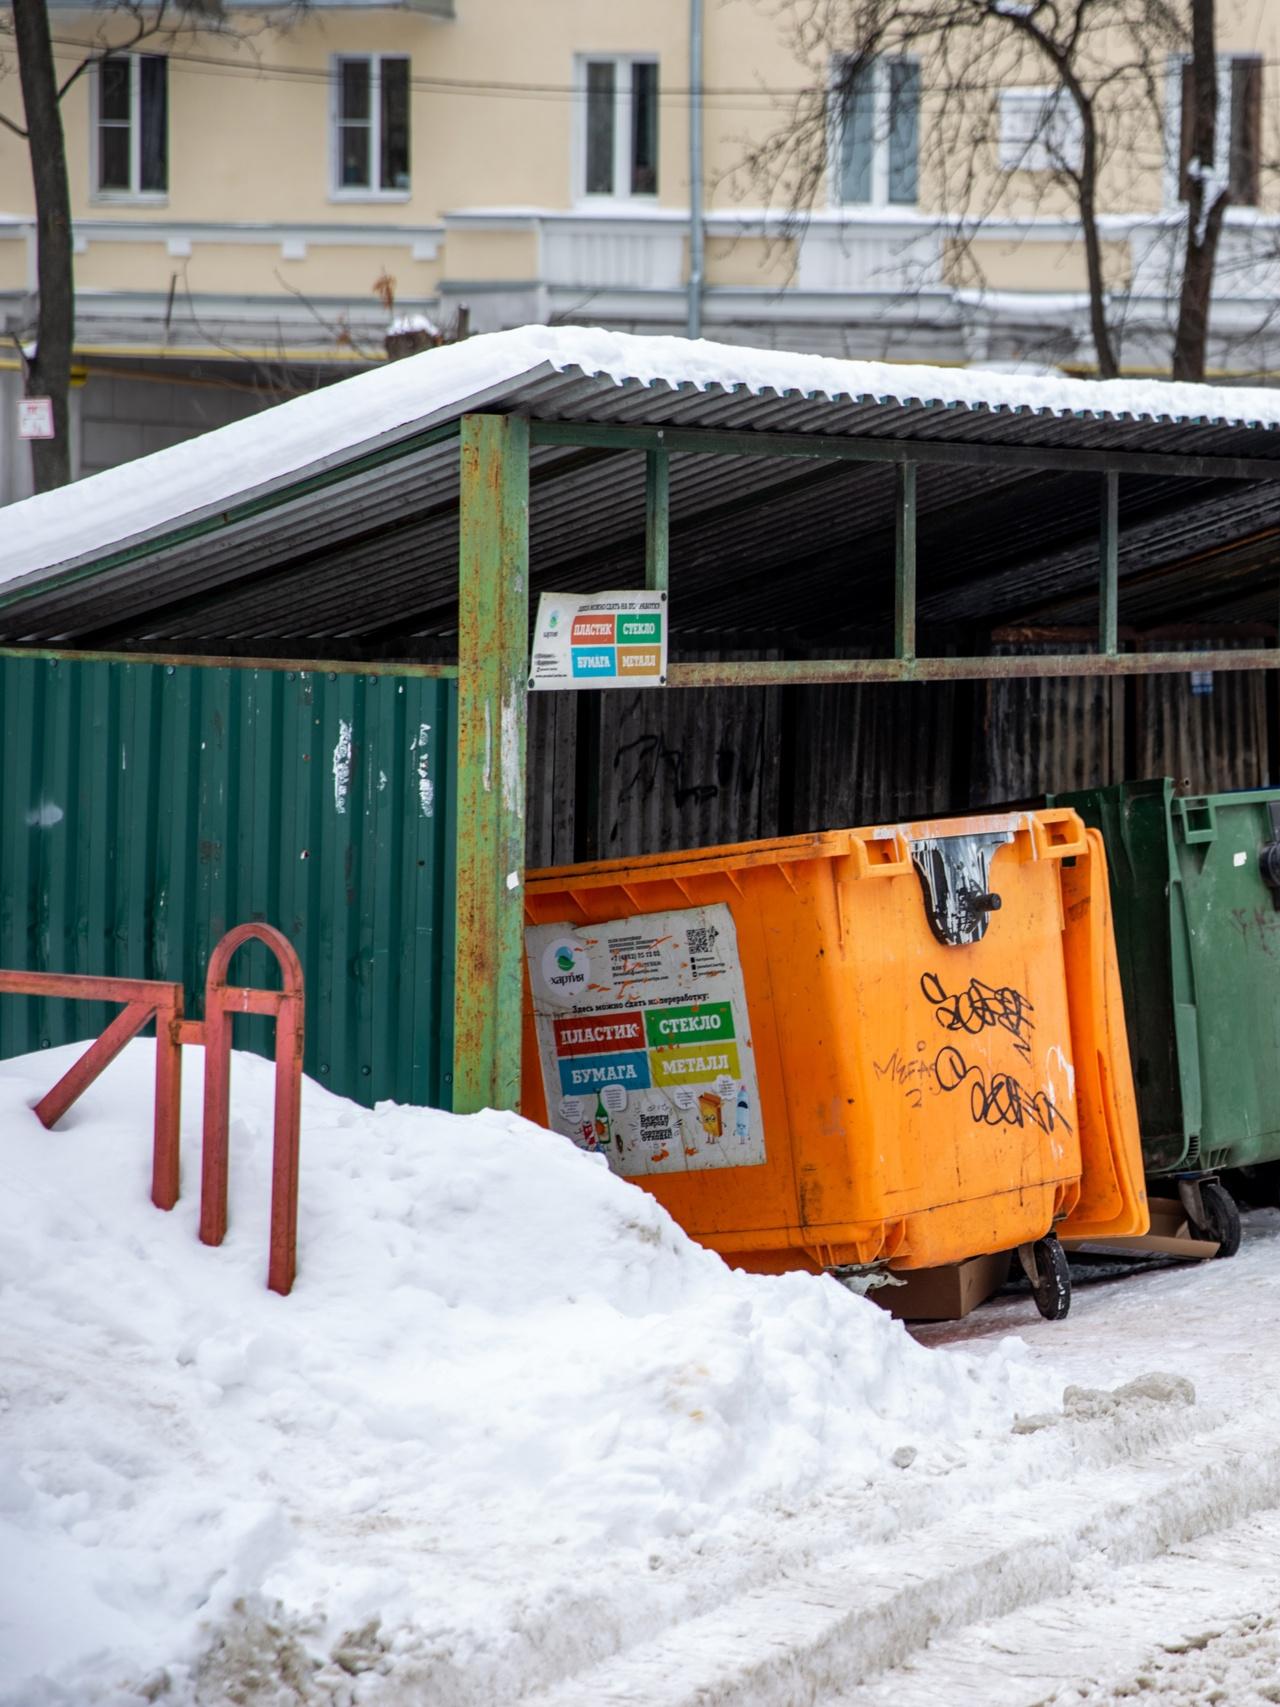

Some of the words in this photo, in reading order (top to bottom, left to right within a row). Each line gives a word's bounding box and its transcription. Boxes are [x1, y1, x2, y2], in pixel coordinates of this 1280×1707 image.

[574, 624, 612, 635] ПЛАСТИК
[623, 623, 655, 634] СТЕКЛО
[577, 656, 610, 668] БУМАГА
[623, 655, 656, 666] МЕТАЛЛ
[595, 1003, 624, 1011] можно
[561, 1025, 638, 1044] ПЛАСТИК
[660, 1014, 721, 1034] СТЕКЛО
[572, 1064, 637, 1084] БУМАГА
[663, 1055, 728, 1074] МЕТАЛЛ
